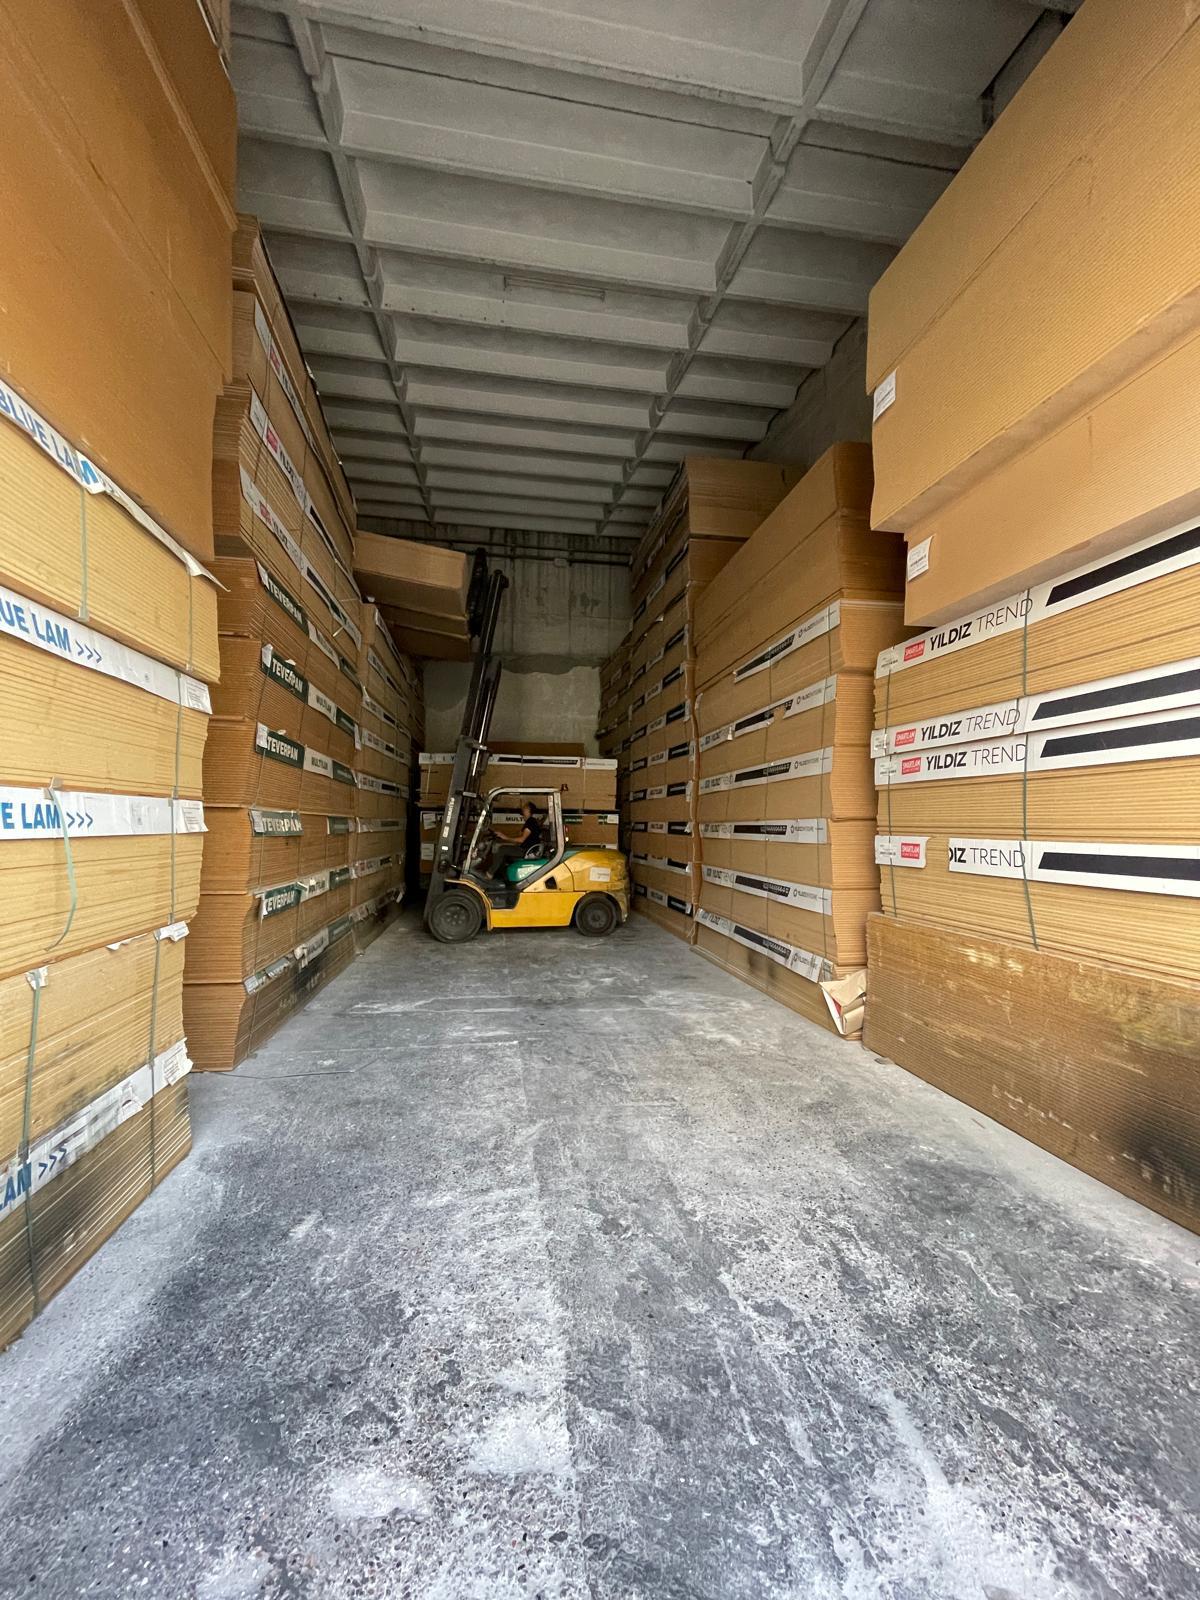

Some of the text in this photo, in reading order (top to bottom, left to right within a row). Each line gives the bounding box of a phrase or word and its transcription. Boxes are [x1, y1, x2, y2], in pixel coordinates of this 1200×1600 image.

[0, 598, 71, 653] UE LAM
[930, 622, 972, 651] YILDIZ
[976, 598, 1033, 632] TREND
[921, 720, 962, 742] YILDIZ
[966, 708, 1020, 733] TREND
[267, 735, 298, 761] TEVERPAN
[926, 751, 967, 771] YILDIZ
[971, 743, 1026, 766] TREND
[21, 803, 61, 829] LAM
[970, 848, 1025, 867] TREND
[265, 890, 295, 912] EVERPAN
[0, 1162, 32, 1211] AM
